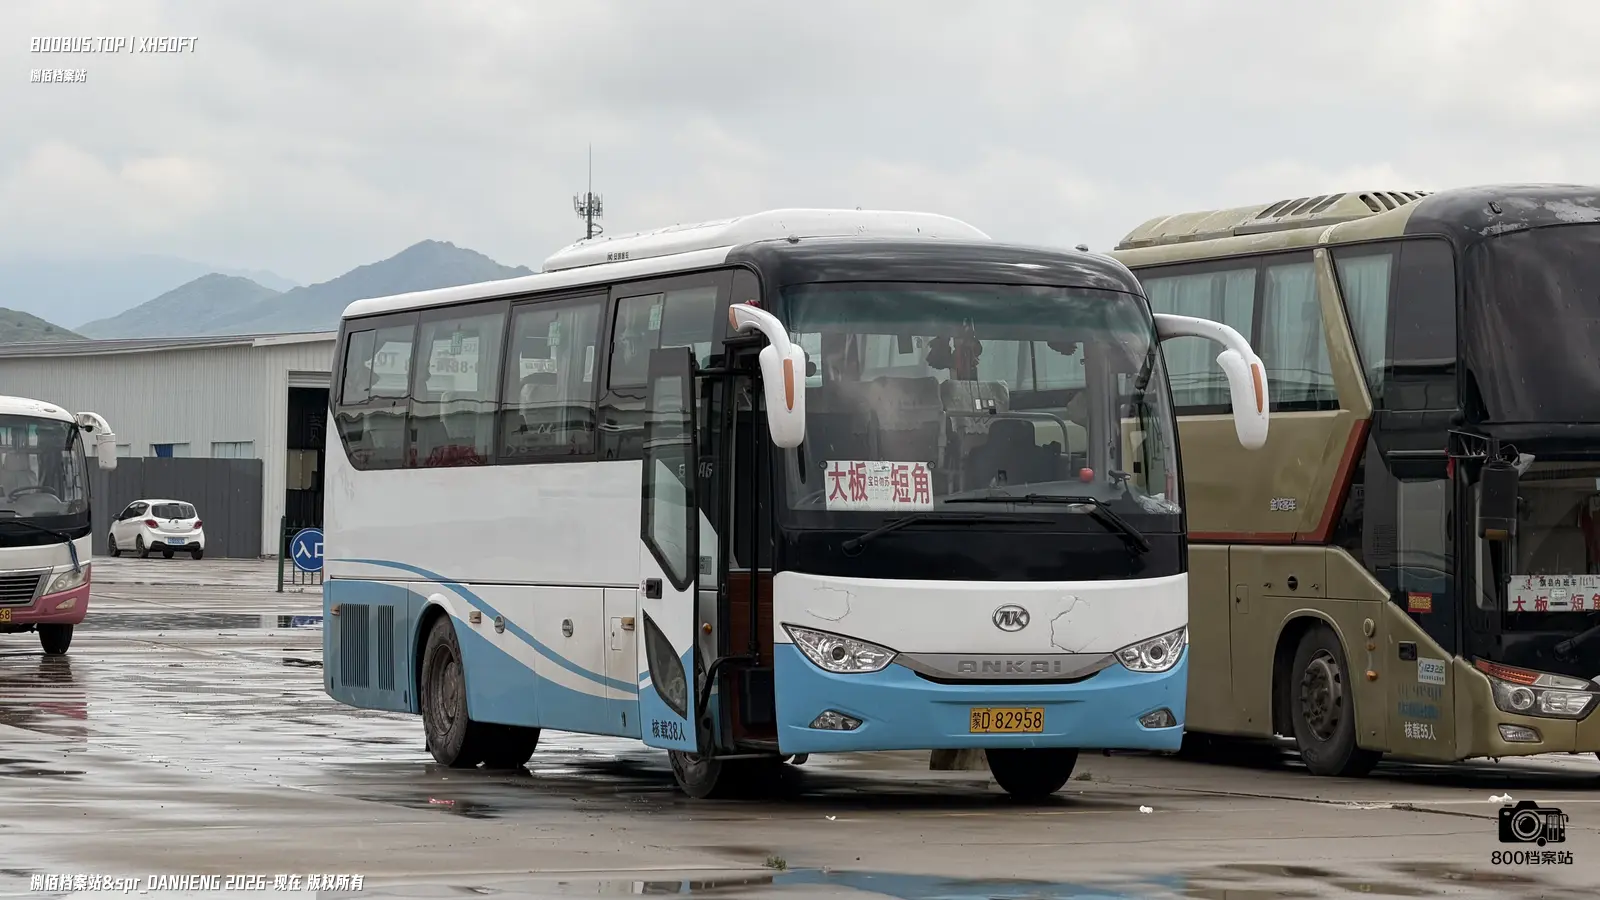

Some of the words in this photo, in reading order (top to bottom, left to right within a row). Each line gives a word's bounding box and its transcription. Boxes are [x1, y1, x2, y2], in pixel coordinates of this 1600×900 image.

[828, 461, 869, 502] 大板
[891, 463, 931, 504] 短角
[957, 660, 1062, 674] ANKAI
[651, 719, 686, 742] 核载38人
[1404, 721, 1436, 741] 核载55人
